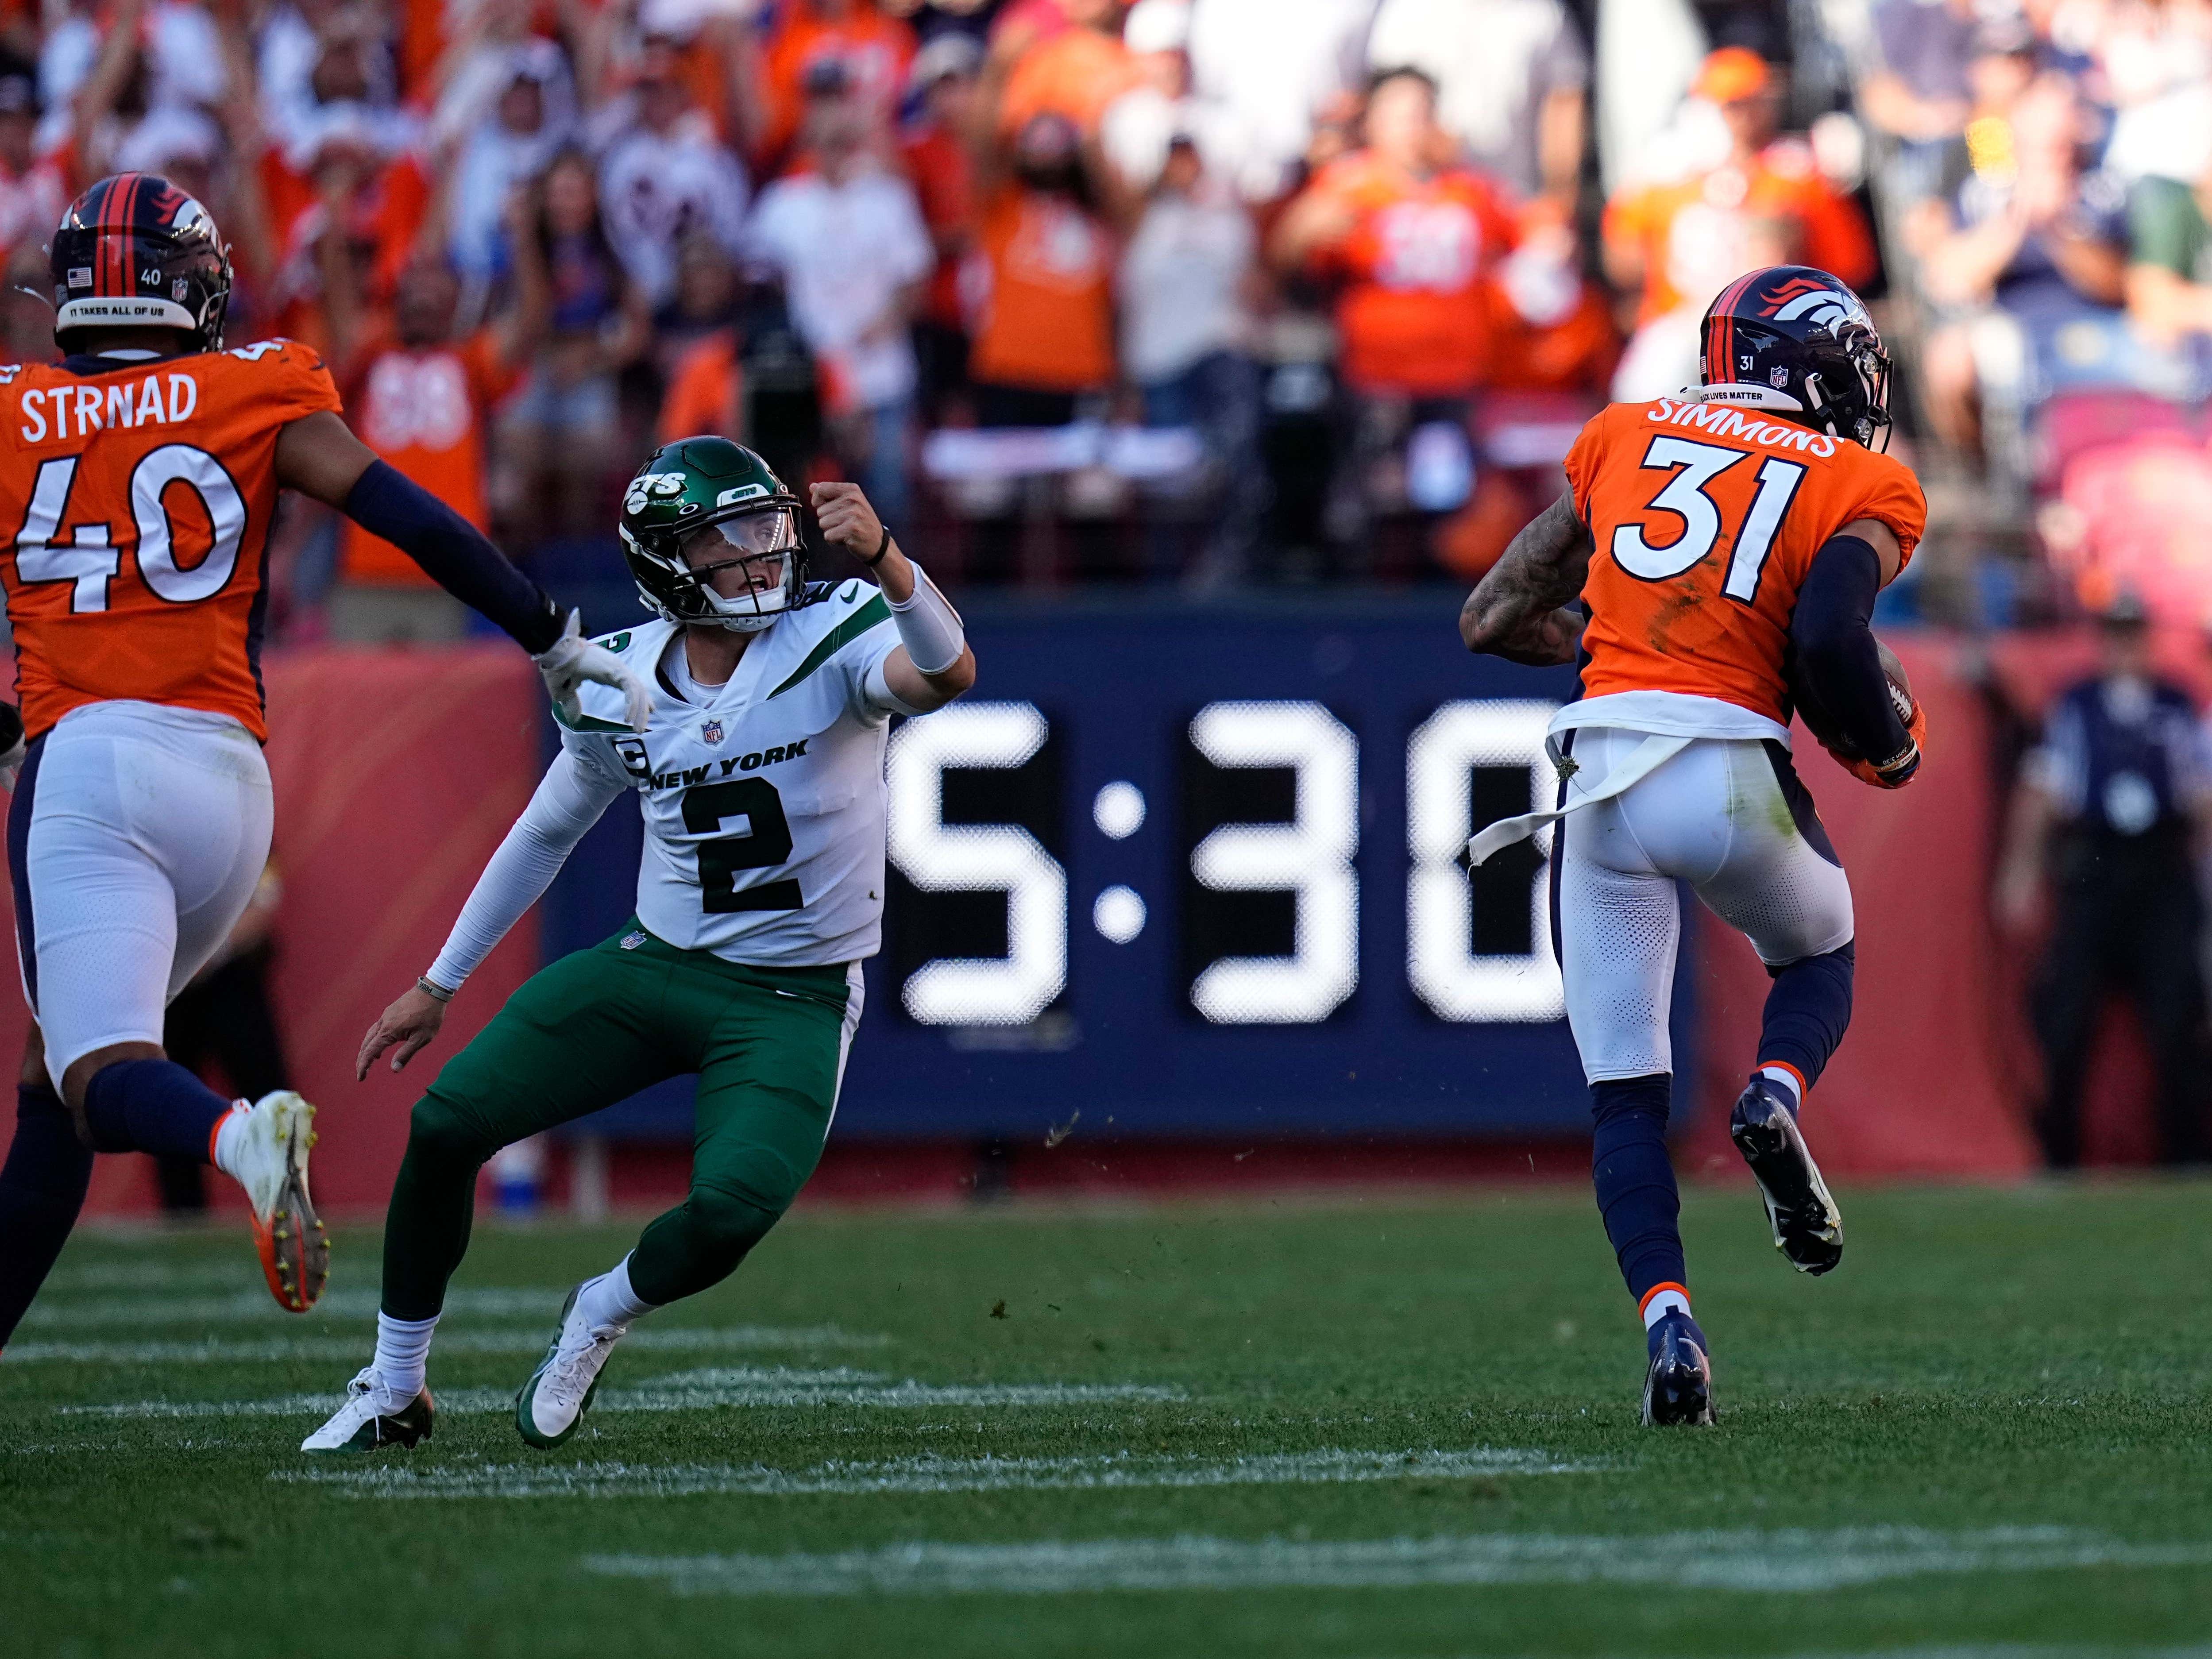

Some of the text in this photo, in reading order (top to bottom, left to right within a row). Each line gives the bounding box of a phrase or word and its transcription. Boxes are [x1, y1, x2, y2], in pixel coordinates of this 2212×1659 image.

[141, 268, 161, 286] 40
[70, 306, 165, 316] IT TAKES ALL OF US
[1740, 355, 1753, 370] 31
[1772, 375, 1785, 385] NFL
[21, 373, 197, 443] STRNAD
[1729, 392, 1763, 401] MATTER
[1647, 397, 1845, 458] SIMMONS
[625, 472, 686, 501] ETS
[731, 486, 757, 499] JETS
[15, 443, 249, 614] 40
[1610, 434, 1809, 607] 31
[706, 730, 721, 741] NFL
[615, 742, 646, 769] C
[649, 739, 809, 790] NEW YORK
[1883, 747, 1907, 765] John 3:30
[681, 776, 804, 914] 2
[886, 699, 1568, 1025] 5:30
